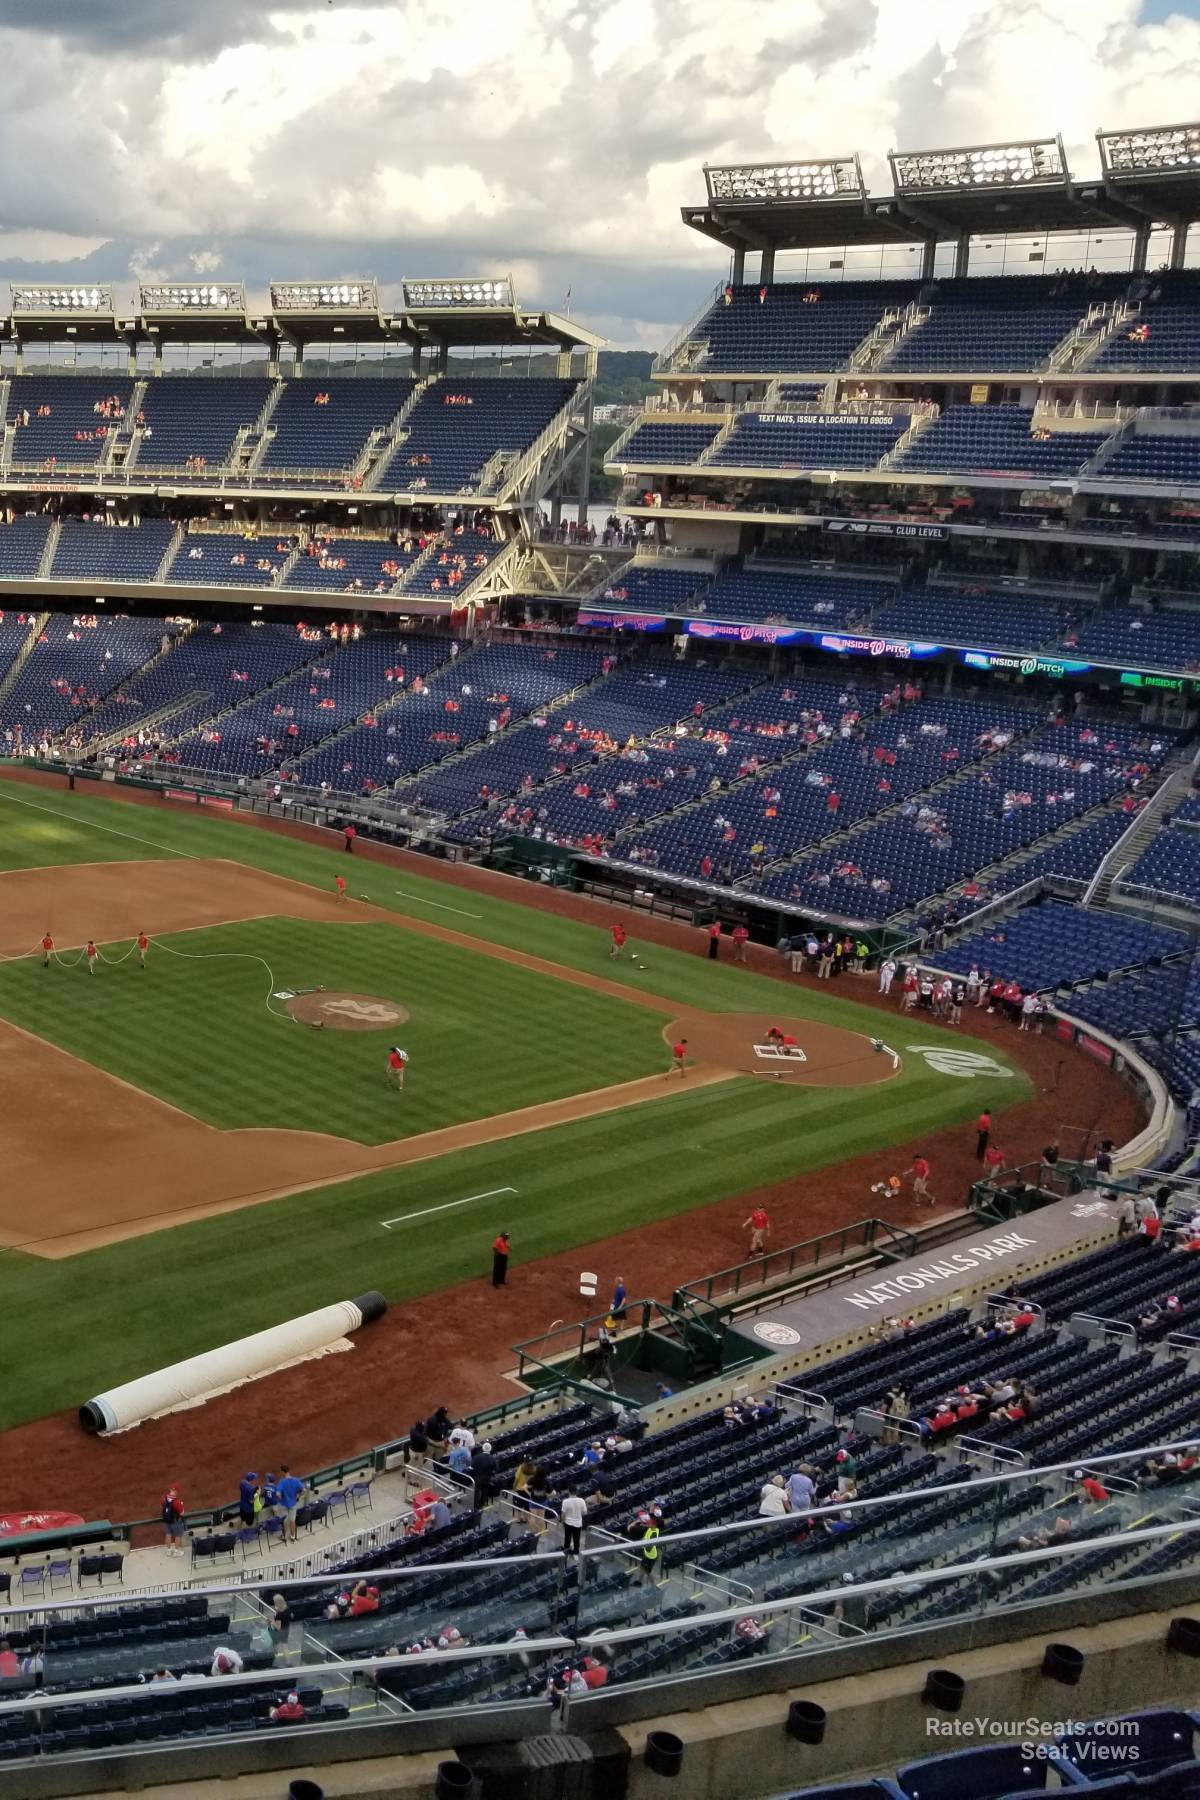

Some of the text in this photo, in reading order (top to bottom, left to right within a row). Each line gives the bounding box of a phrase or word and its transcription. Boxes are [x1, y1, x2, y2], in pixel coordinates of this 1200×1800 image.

[758, 414, 774, 422] TEXT
[797, 415, 817, 423] ISSUE
[826, 416, 858, 424] LOCATION
[860, 416, 869, 424] TO
[896, 526, 917, 535] CLUB
[919, 527, 943, 537] LEVEL
[712, 626, 740, 636] INSIDE
[754, 629, 778, 639] PITCH
[841, 639, 870, 650] INSIDE
[885, 645, 912, 655] PITCH
[989, 656, 1020, 668] INSIDE
[1037, 662, 1064, 673] PITCH
[1145, 676, 1177, 688] INSIDE
[843, 1232, 1037, 1311] NATIONALS PARK
